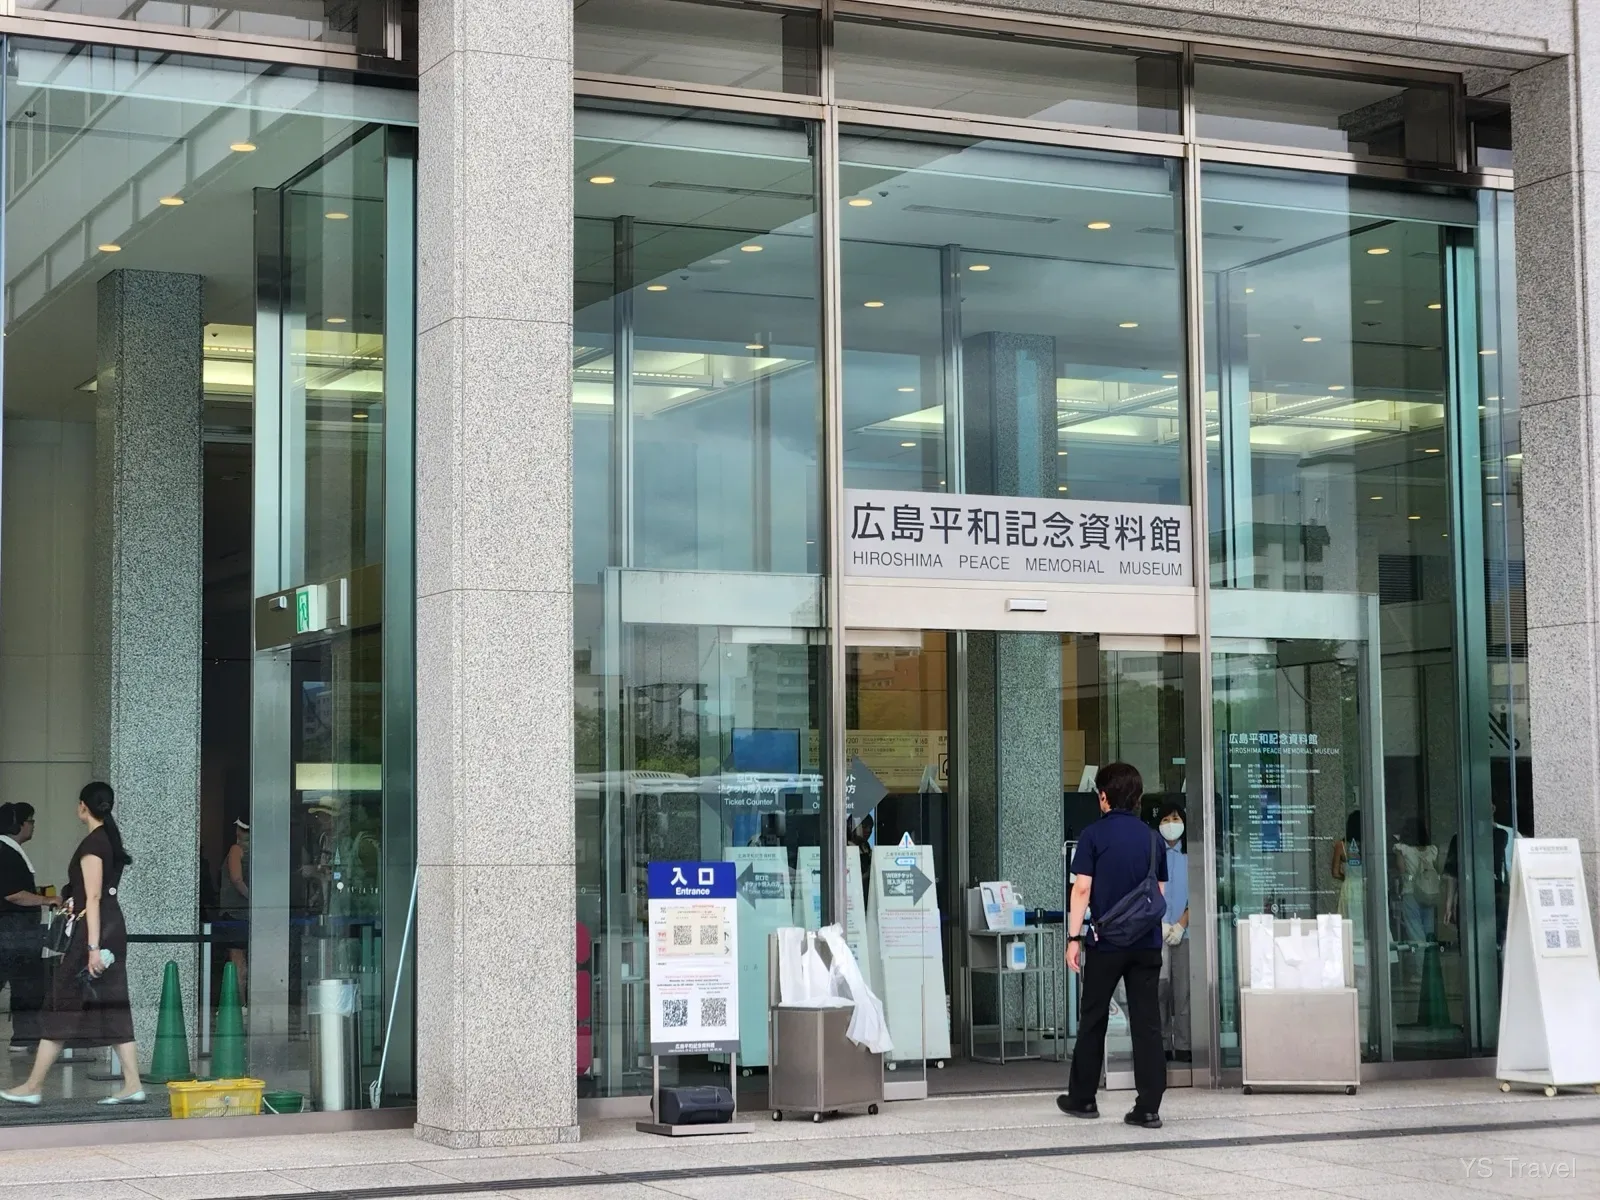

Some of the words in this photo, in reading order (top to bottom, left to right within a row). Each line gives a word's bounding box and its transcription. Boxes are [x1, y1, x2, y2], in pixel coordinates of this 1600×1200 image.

[850, 502, 1182, 553] 広島平和記念資料館
[853, 551, 943, 568] HIROSHIMA
[959, 555, 1010, 571] PEACE
[1025, 558, 1105, 574] MEMORIAL
[1119, 561, 1182, 576] MUSEUM
[1229, 733, 1318, 745] 広島平和記念資料館
[1314, 748, 1340, 756] MUSEUM
[724, 798, 745, 806] Ticket
[746, 798, 773, 806] Counter
[670, 867, 714, 886] 入口
[675, 886, 711, 896] Entrance
